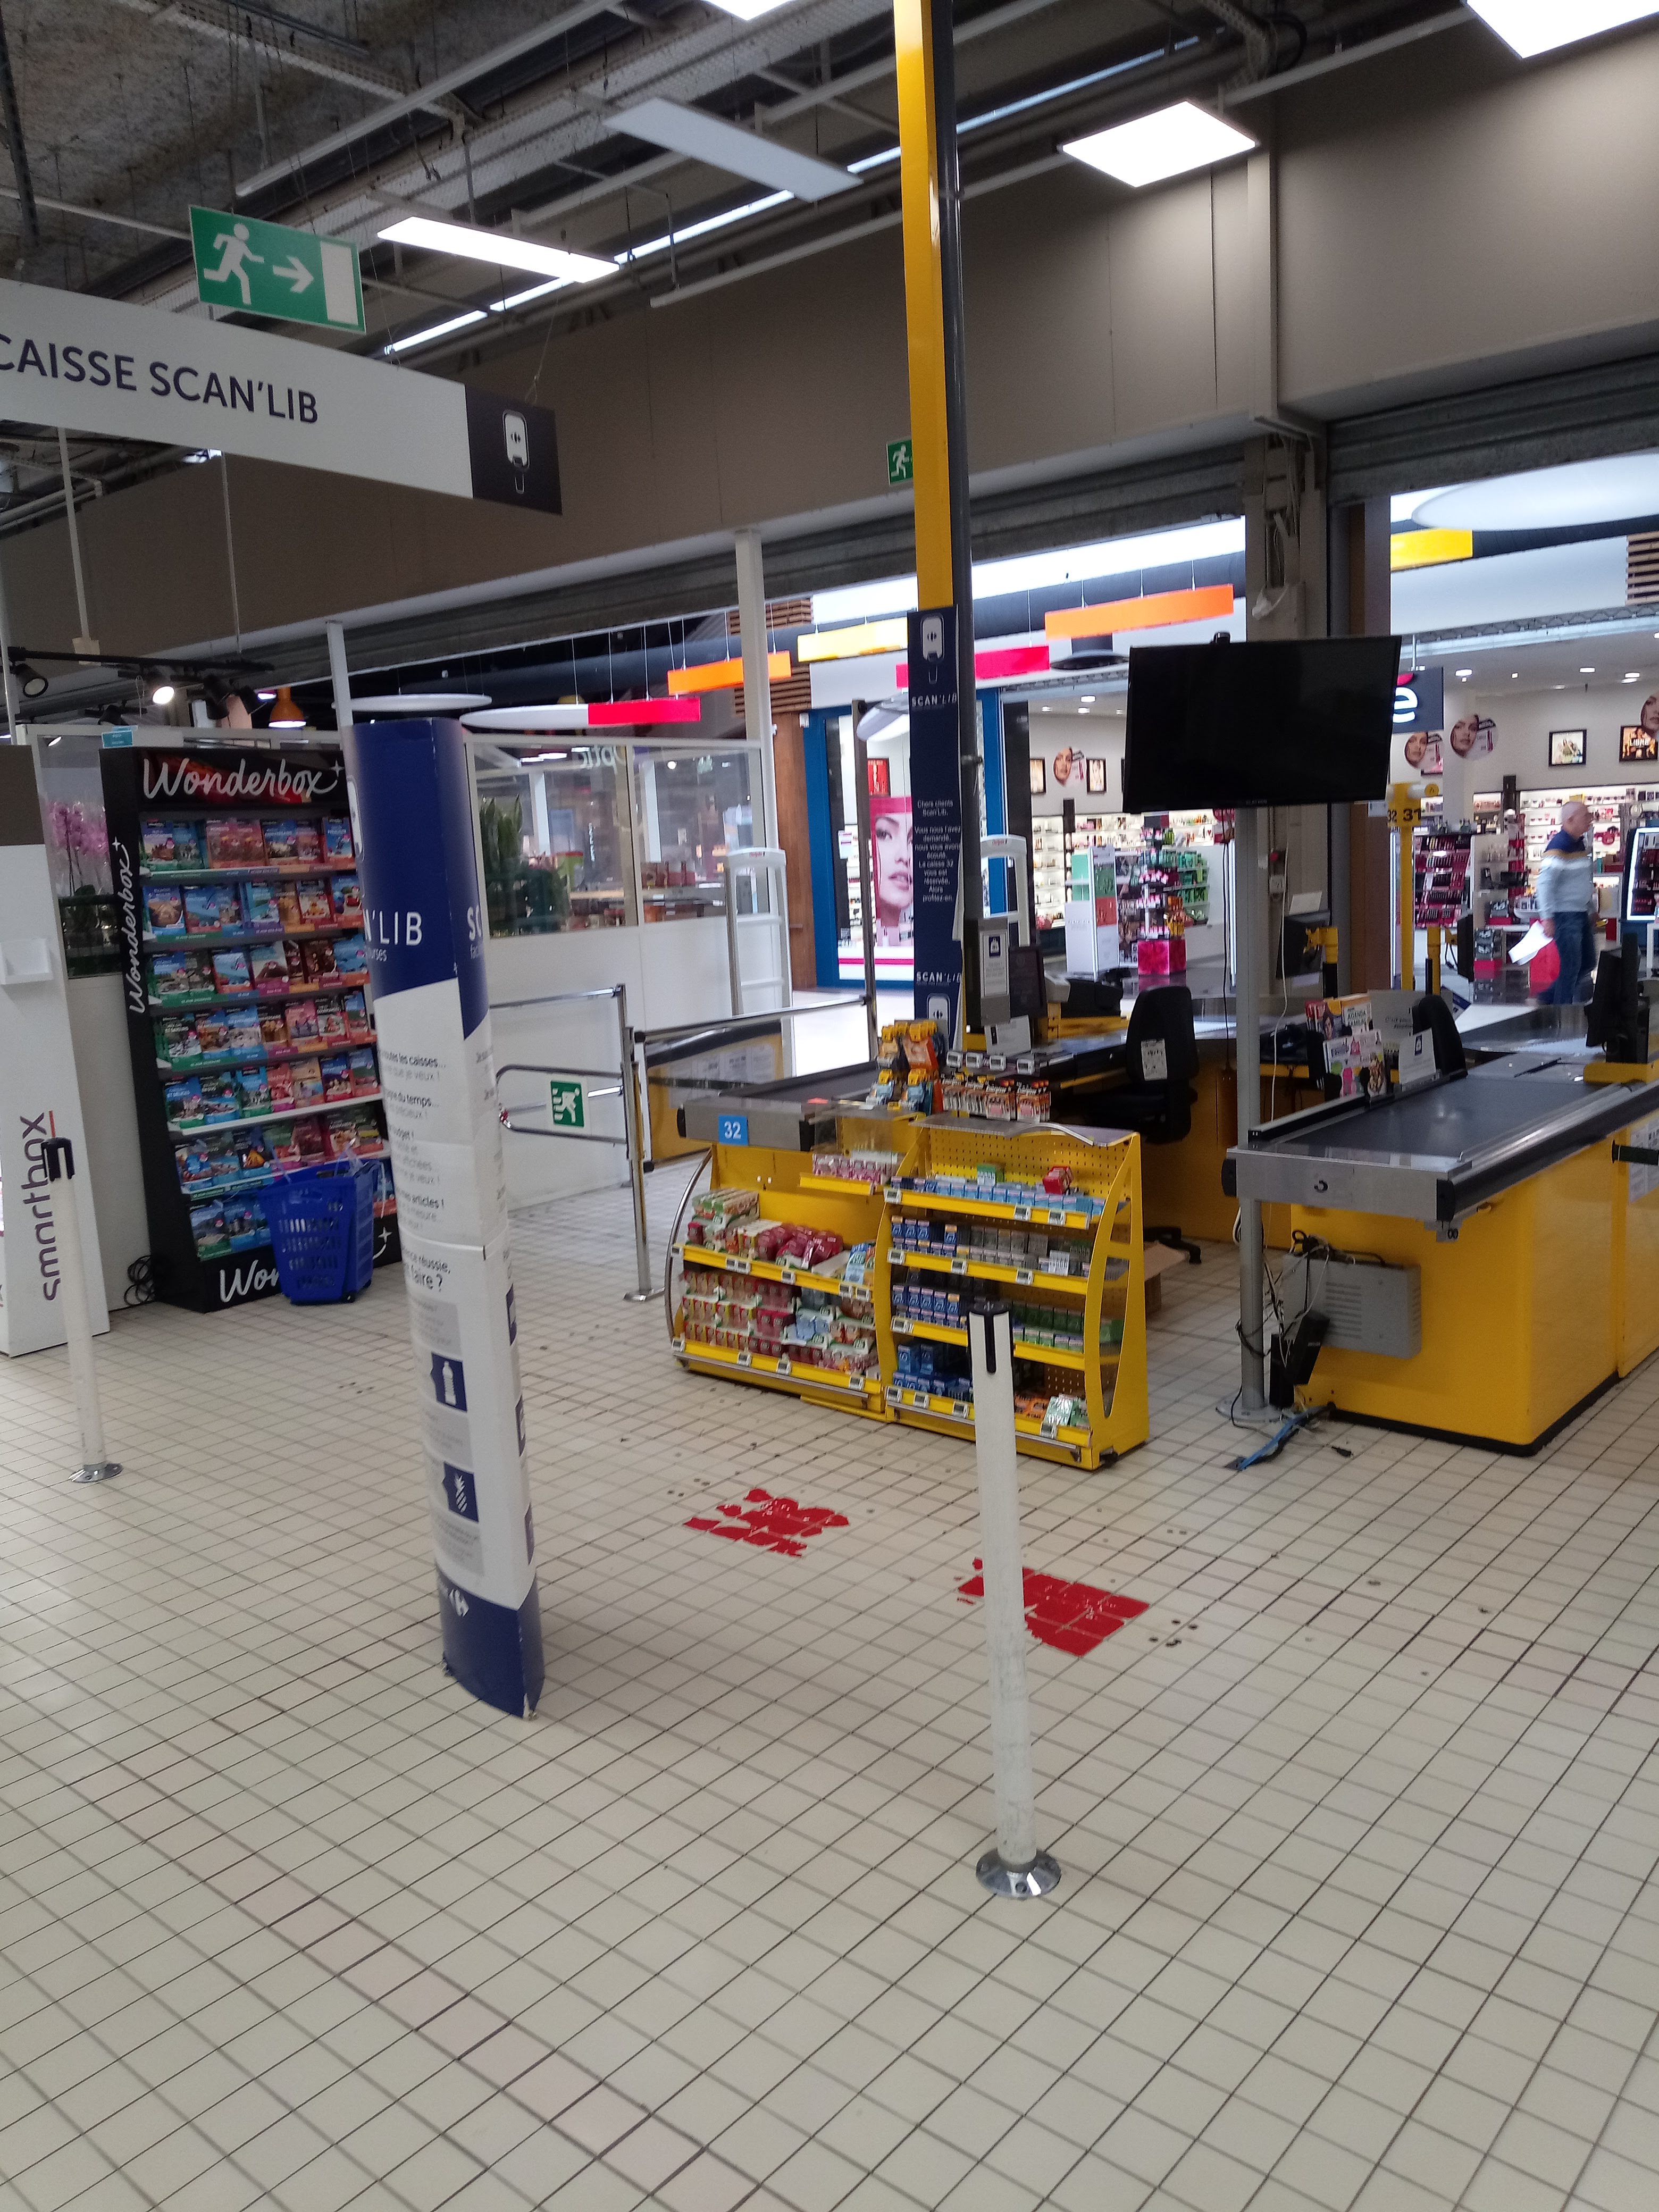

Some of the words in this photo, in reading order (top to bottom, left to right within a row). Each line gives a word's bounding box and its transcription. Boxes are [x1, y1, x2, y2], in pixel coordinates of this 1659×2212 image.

[149, 362, 319, 424] SCAN'LIB
[911, 692, 957, 707] SCAN'LIB
[143, 758, 340, 799] Wonderbox
[1403, 808, 1421, 822] 31
[113, 843, 146, 1014] Wonderbox
[916, 971, 961, 984] SCAN'LIB
[724, 1121, 742, 1139] 32
[19, 1112, 61, 1301] smartbox
